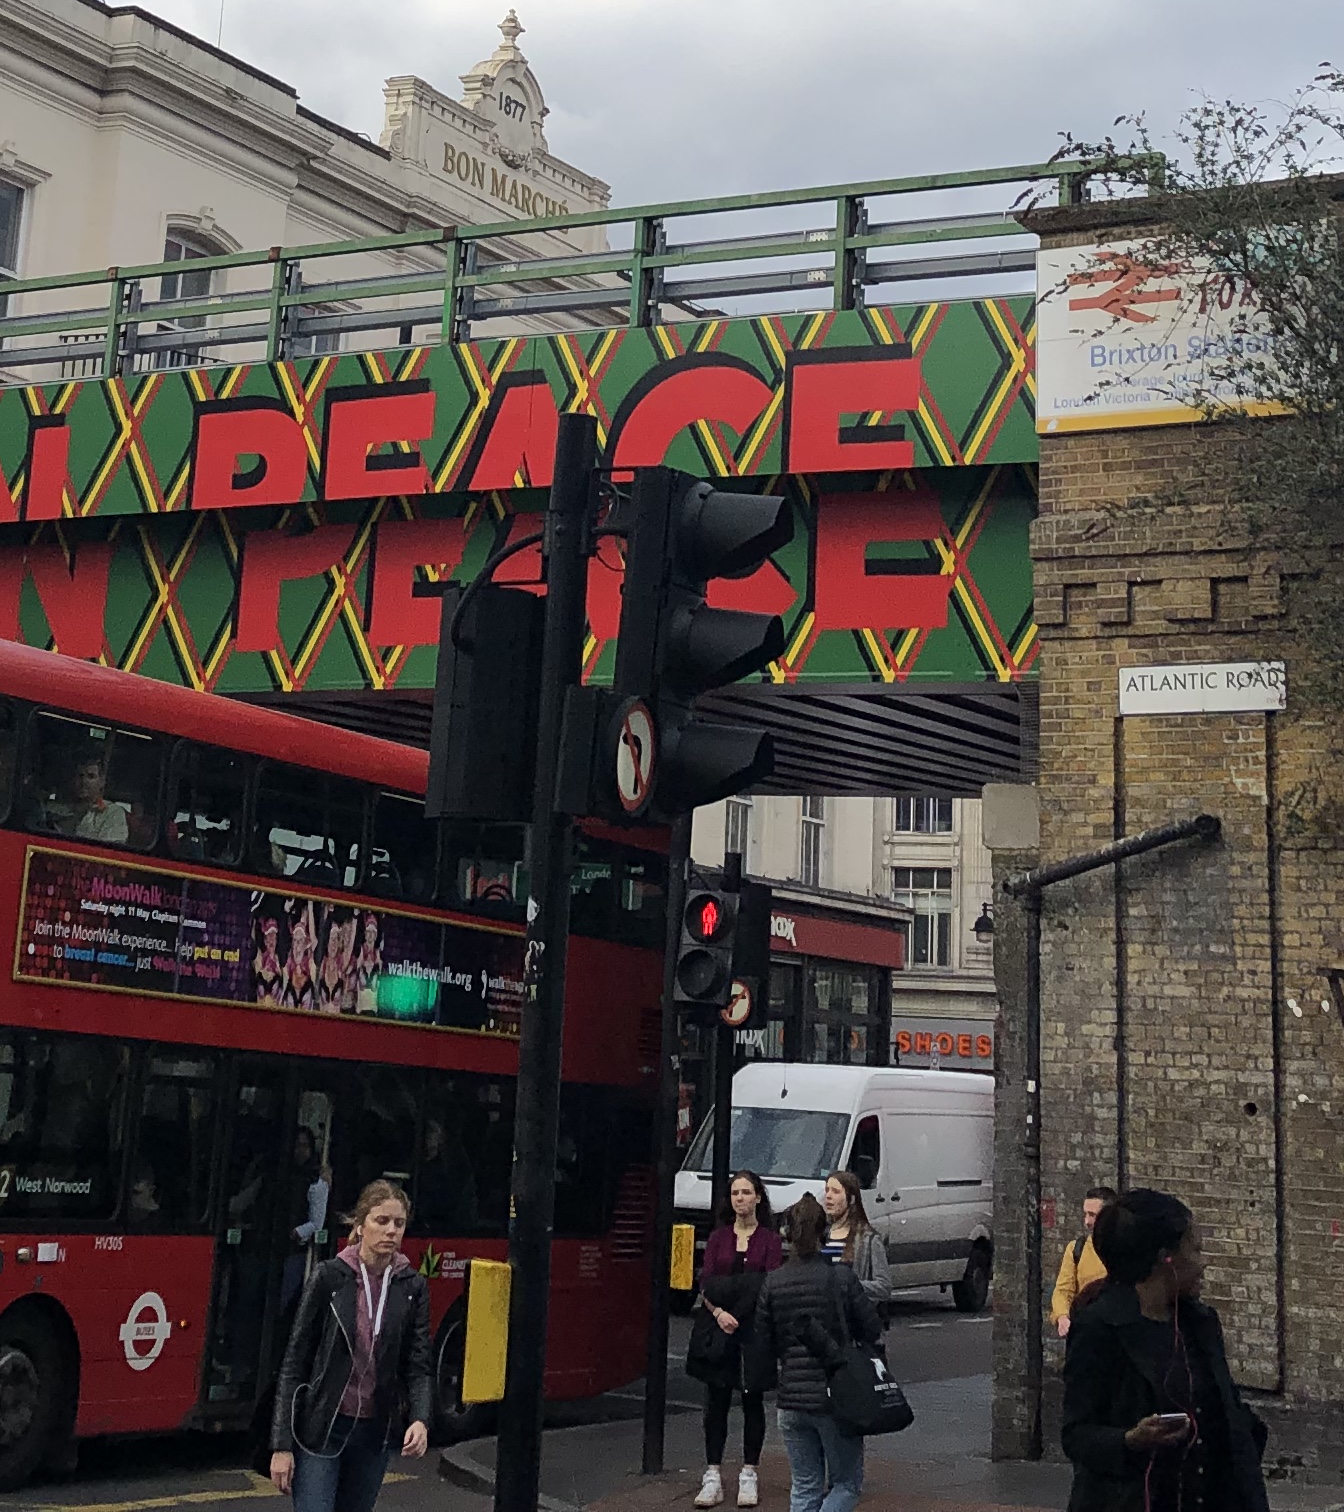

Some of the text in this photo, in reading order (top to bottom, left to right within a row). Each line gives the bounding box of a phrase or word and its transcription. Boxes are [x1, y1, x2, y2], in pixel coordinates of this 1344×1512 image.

[498, 91, 527, 123] 1877
[442, 141, 486, 190] BON
[1090, 341, 1178, 369] Brixton
[1104, 390, 1151, 405] Victoria
[192, 354, 955, 652] PEACE
[1126, 670, 1279, 693] ATLANTIC ROAD
[91, 877, 162, 906] MoonWalk
[34, 919, 53, 937] Join
[55, 920, 71, 938] the
[72, 923, 121, 945] MoonWalk
[53, 944, 63, 959] to
[387, 958, 473, 992] walkthewalk.org
[896, 1030, 992, 1058] SHOES
[0, 1169, 92, 1198] 2 West Norwood
[94, 1236, 124, 1251] HV305
